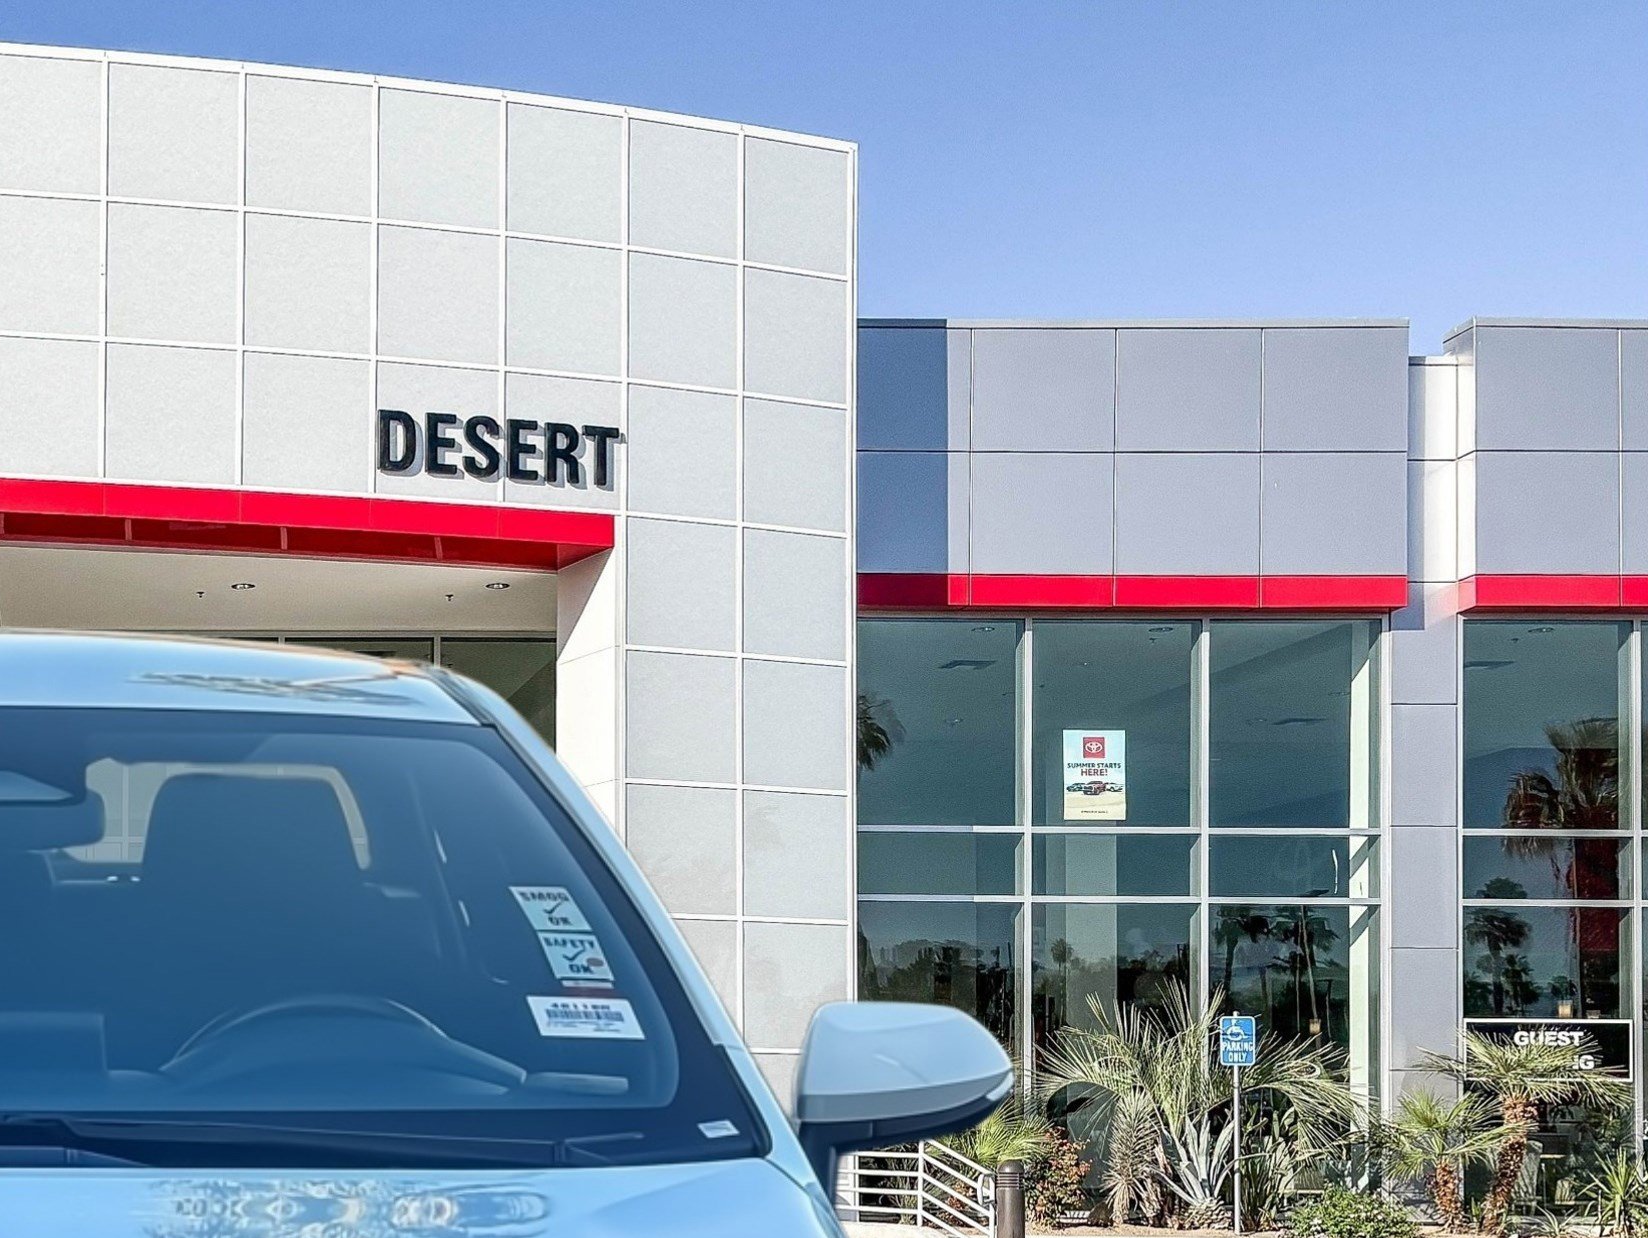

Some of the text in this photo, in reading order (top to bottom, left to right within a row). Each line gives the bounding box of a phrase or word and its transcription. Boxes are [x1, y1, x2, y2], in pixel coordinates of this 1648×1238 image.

[377, 409, 620, 486] DESERT
[1080, 768, 1108, 776] HERE!
[543, 937, 595, 949] SAFETY
[568, 963, 594, 974] OK
[1514, 1031, 1584, 1046] GUEST
[1222, 1041, 1253, 1052] PARKING
[1228, 1051, 1247, 1063] ONLY
